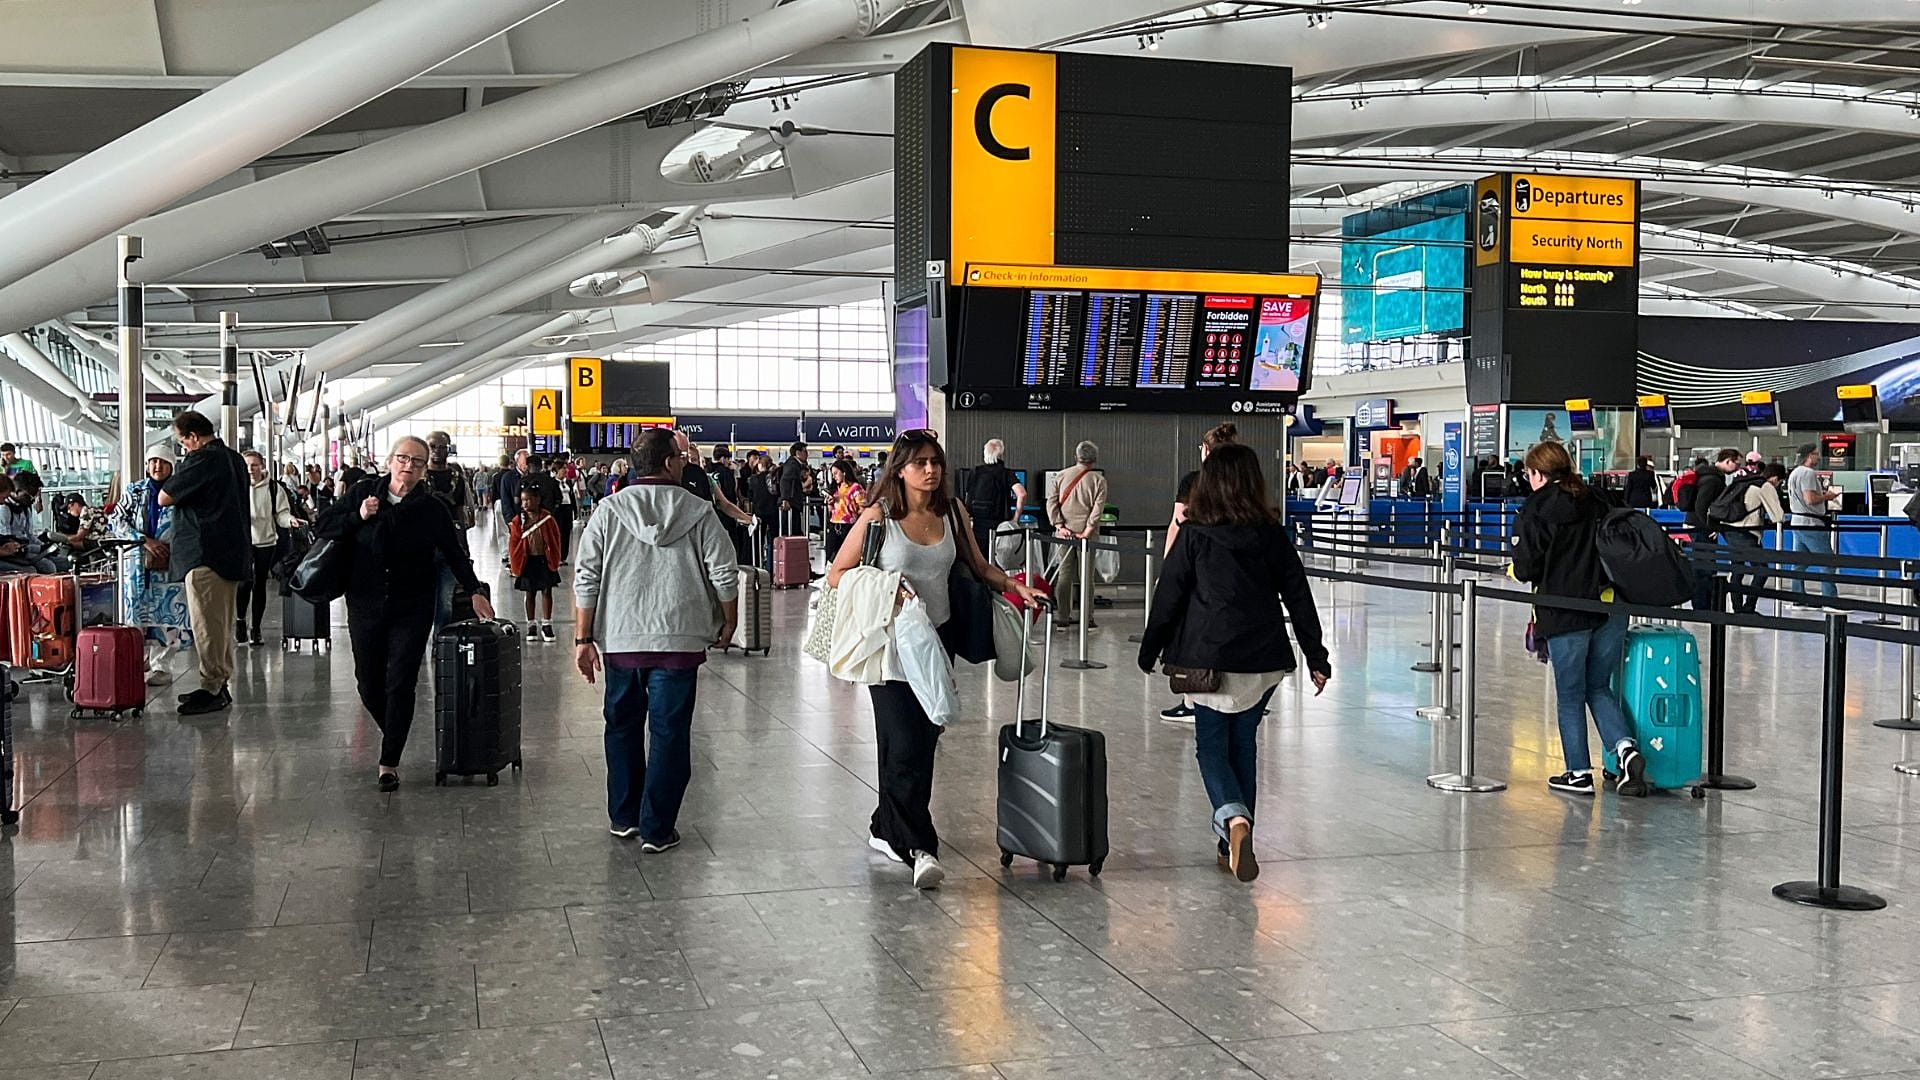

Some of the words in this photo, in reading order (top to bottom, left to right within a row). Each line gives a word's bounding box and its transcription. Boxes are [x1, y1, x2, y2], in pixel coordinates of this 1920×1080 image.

[974, 83, 1030, 161] C
[1533, 187, 1624, 207] Departures
[1532, 234, 1583, 251] Security
[1586, 237, 1623, 249] North
[984, 270, 1026, 281] Check-in
[1029, 272, 1088, 283] information
[1520, 268, 1542, 279] How
[1543, 269, 1564, 282] busy
[1565, 270, 1573, 280] is
[1574, 270, 1614, 283] Security?
[1520, 283, 1547, 294] North
[1263, 301, 1293, 312] SAVE
[1520, 295, 1547, 306] South
[1207, 311, 1249, 321] Forbidden
[578, 367, 594, 387] B
[537, 395, 552, 410] A
[818, 422, 832, 437] A
[836, 426, 880, 437] warm
